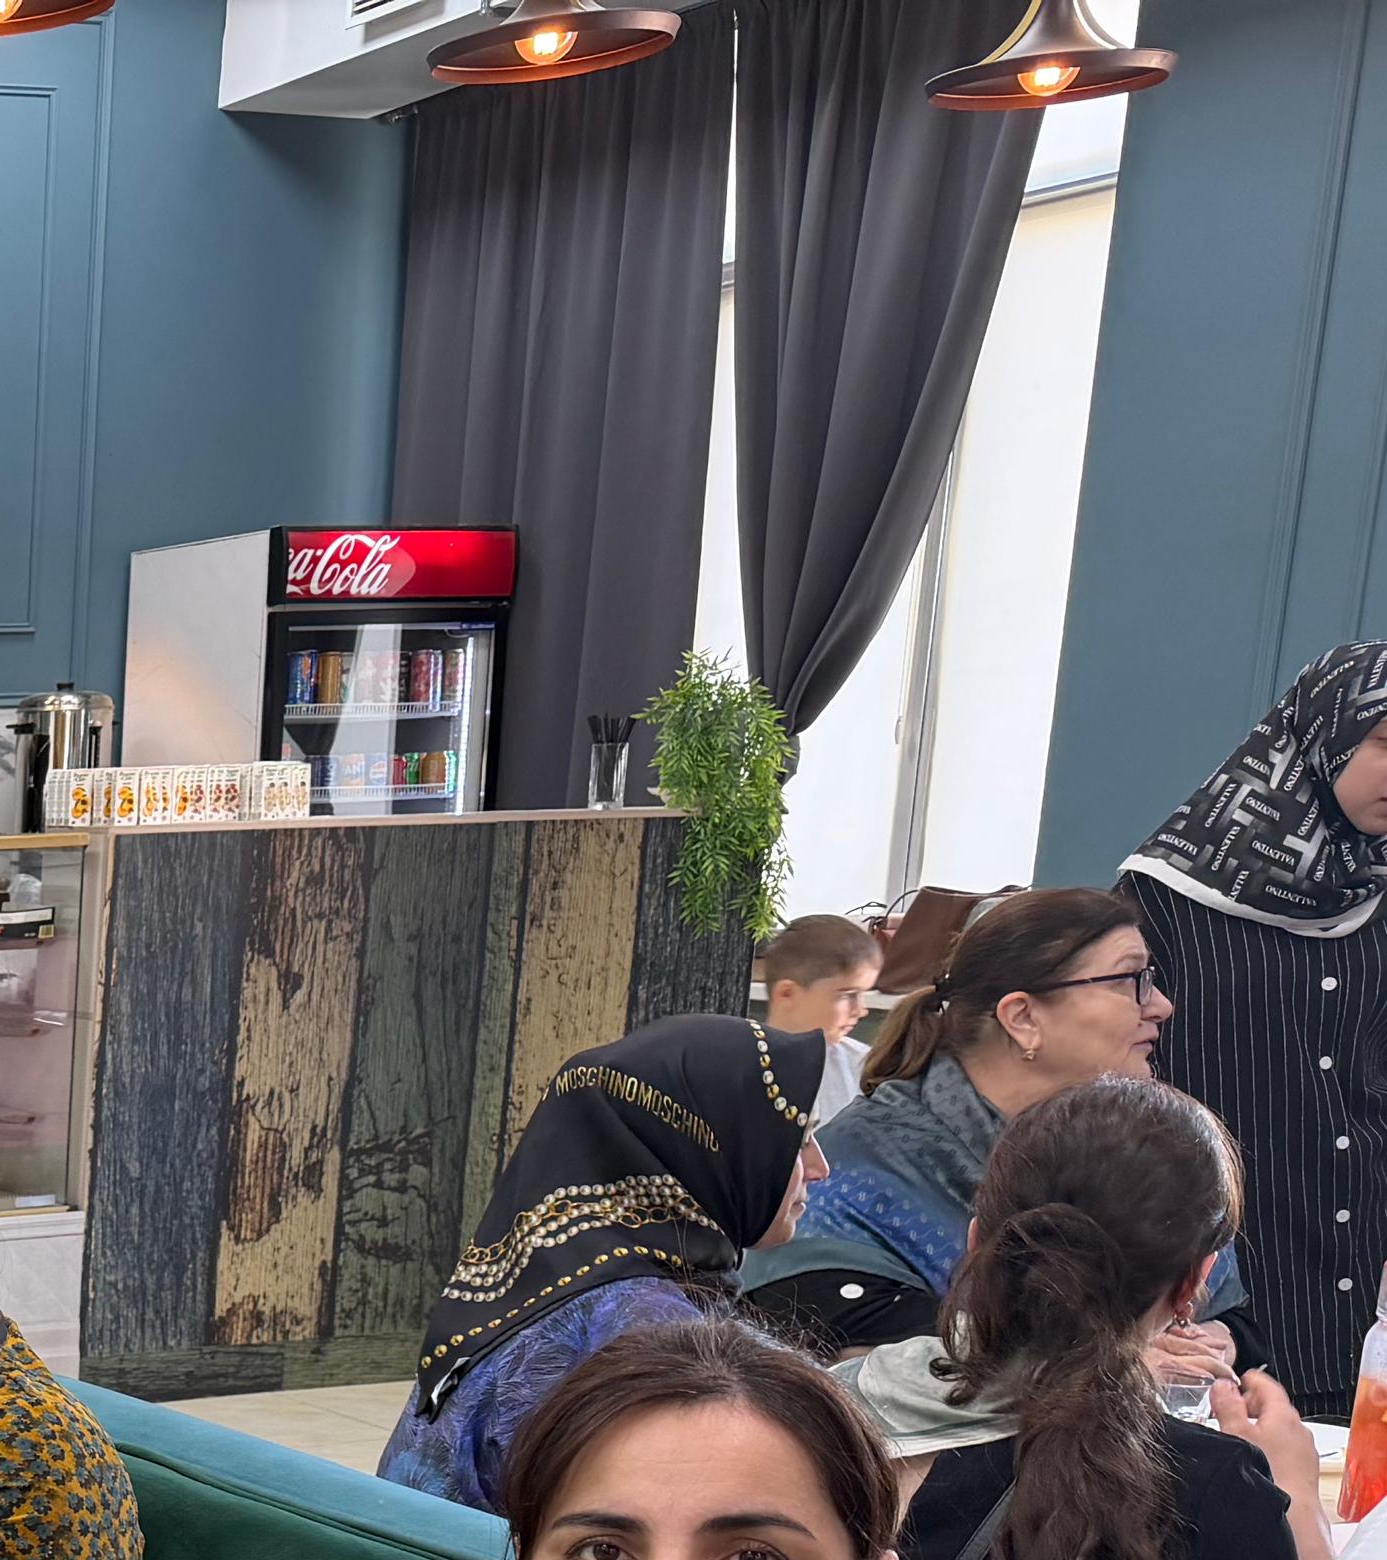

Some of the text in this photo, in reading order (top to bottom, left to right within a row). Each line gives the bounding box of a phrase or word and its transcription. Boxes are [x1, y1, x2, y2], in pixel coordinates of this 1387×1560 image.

[1205, 783, 1237, 828] VALENTINO
[1245, 796, 1281, 822] VALENTINO
[1157, 833, 1198, 856] VALENTINO
[1211, 826, 1241, 871] VALENTINO
[1251, 840, 1295, 867] VALENTINO
[1265, 884, 1317, 907] VALENTINO
